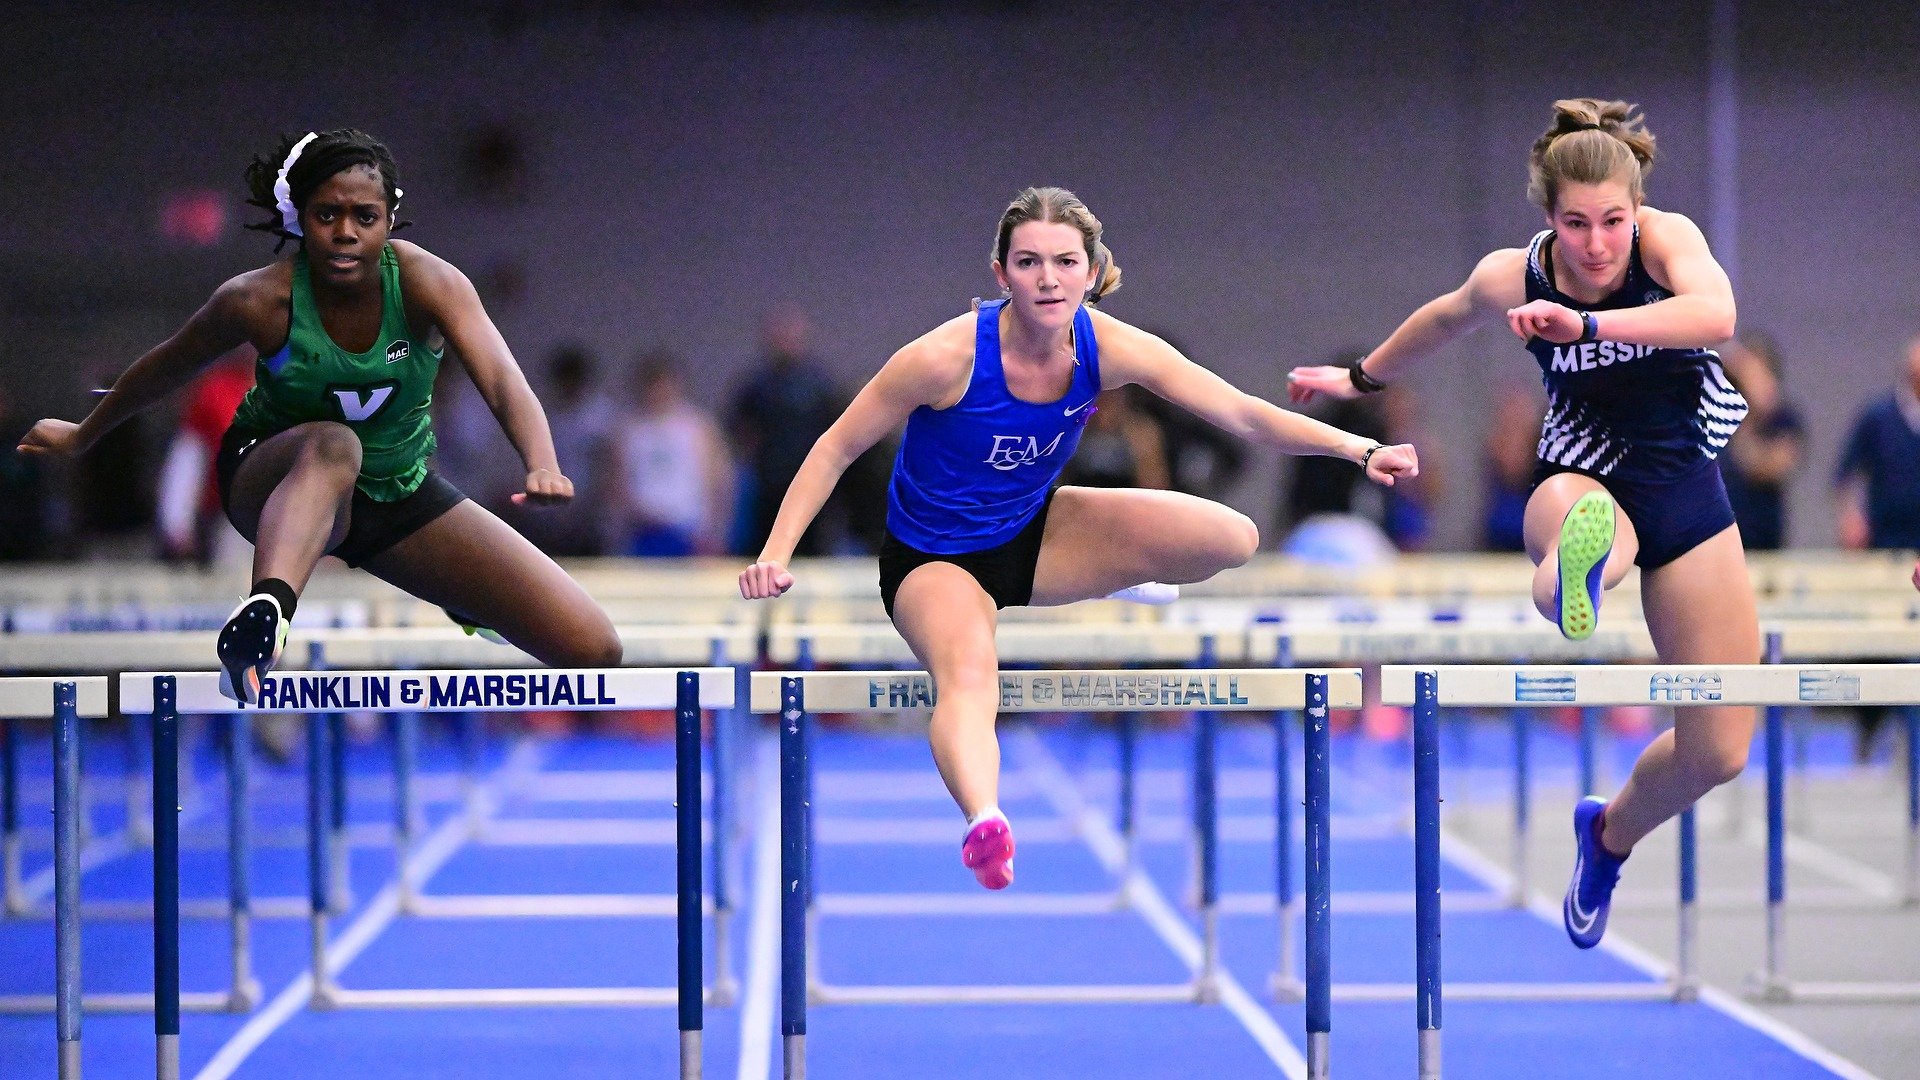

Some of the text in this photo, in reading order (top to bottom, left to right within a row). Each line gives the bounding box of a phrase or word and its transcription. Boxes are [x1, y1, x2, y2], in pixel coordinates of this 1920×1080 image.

[387, 347, 408, 361] MAC
[333, 386, 393, 421] V
[237, 674, 616, 709] RANKLIN & MARSHALL
[869, 676, 1023, 707] FRAN
[1062, 674, 1248, 706] MARSHALL
